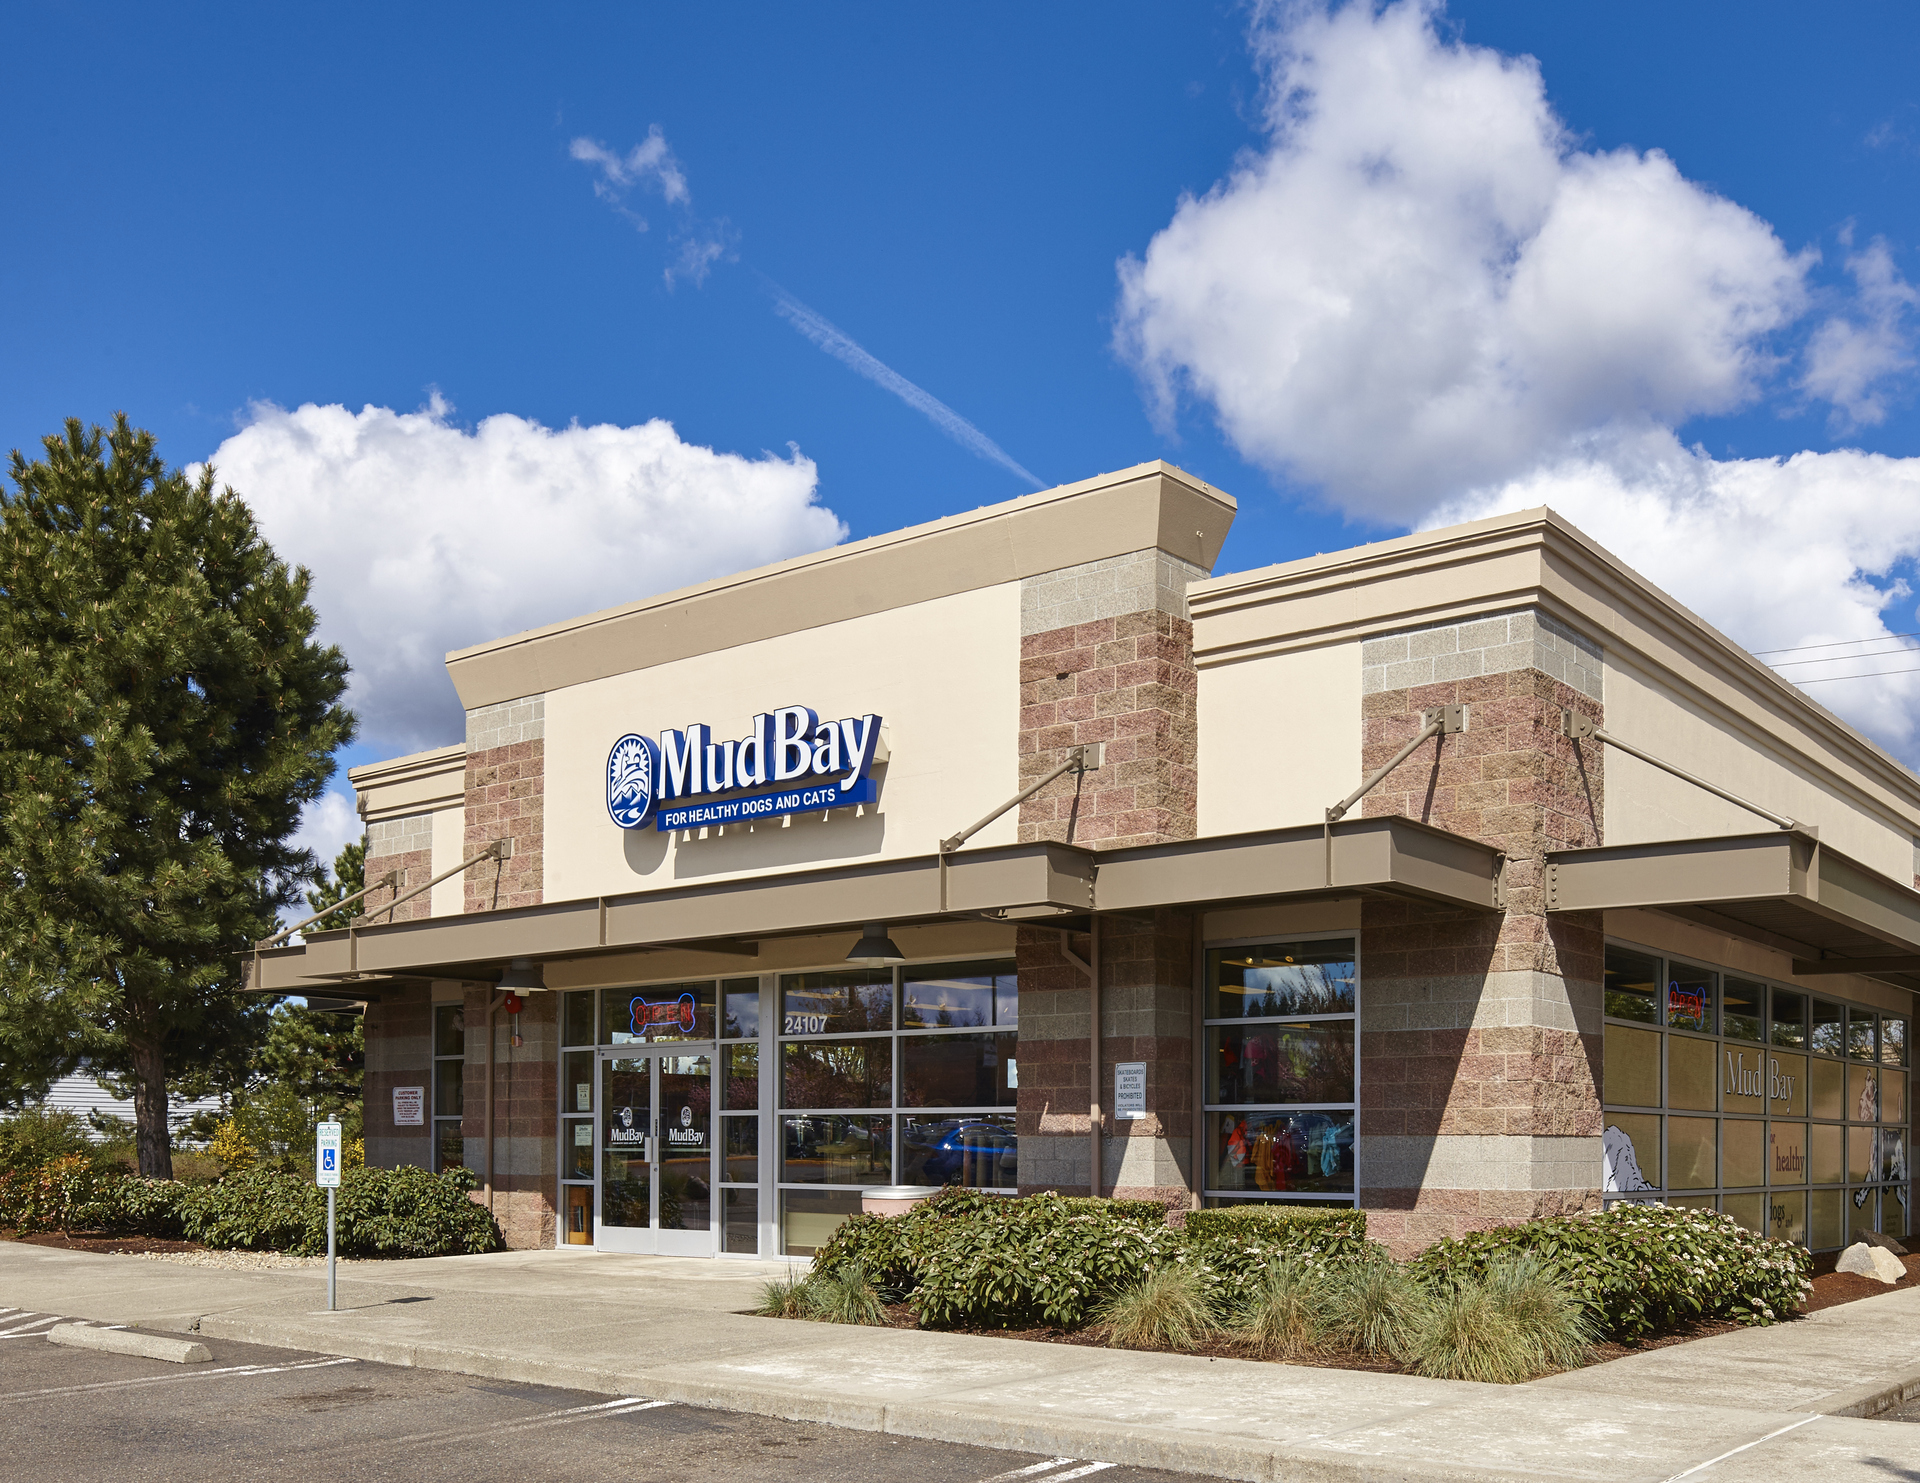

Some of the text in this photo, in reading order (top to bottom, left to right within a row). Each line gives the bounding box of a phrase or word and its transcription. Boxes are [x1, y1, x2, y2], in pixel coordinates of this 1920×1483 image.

[665, 788, 836, 827] FOR HEALTHY DOGS AND CATS
[635, 1002, 692, 1026] OPEN
[1670, 991, 1702, 1019] OPEN
[785, 1015, 828, 1034] 24107
[1726, 1050, 1796, 1114] Mud Bay
[319, 1128, 339, 1136] RESERVED
[320, 1139, 338, 1147] PARKING
[1776, 1145, 1805, 1179] healthy
